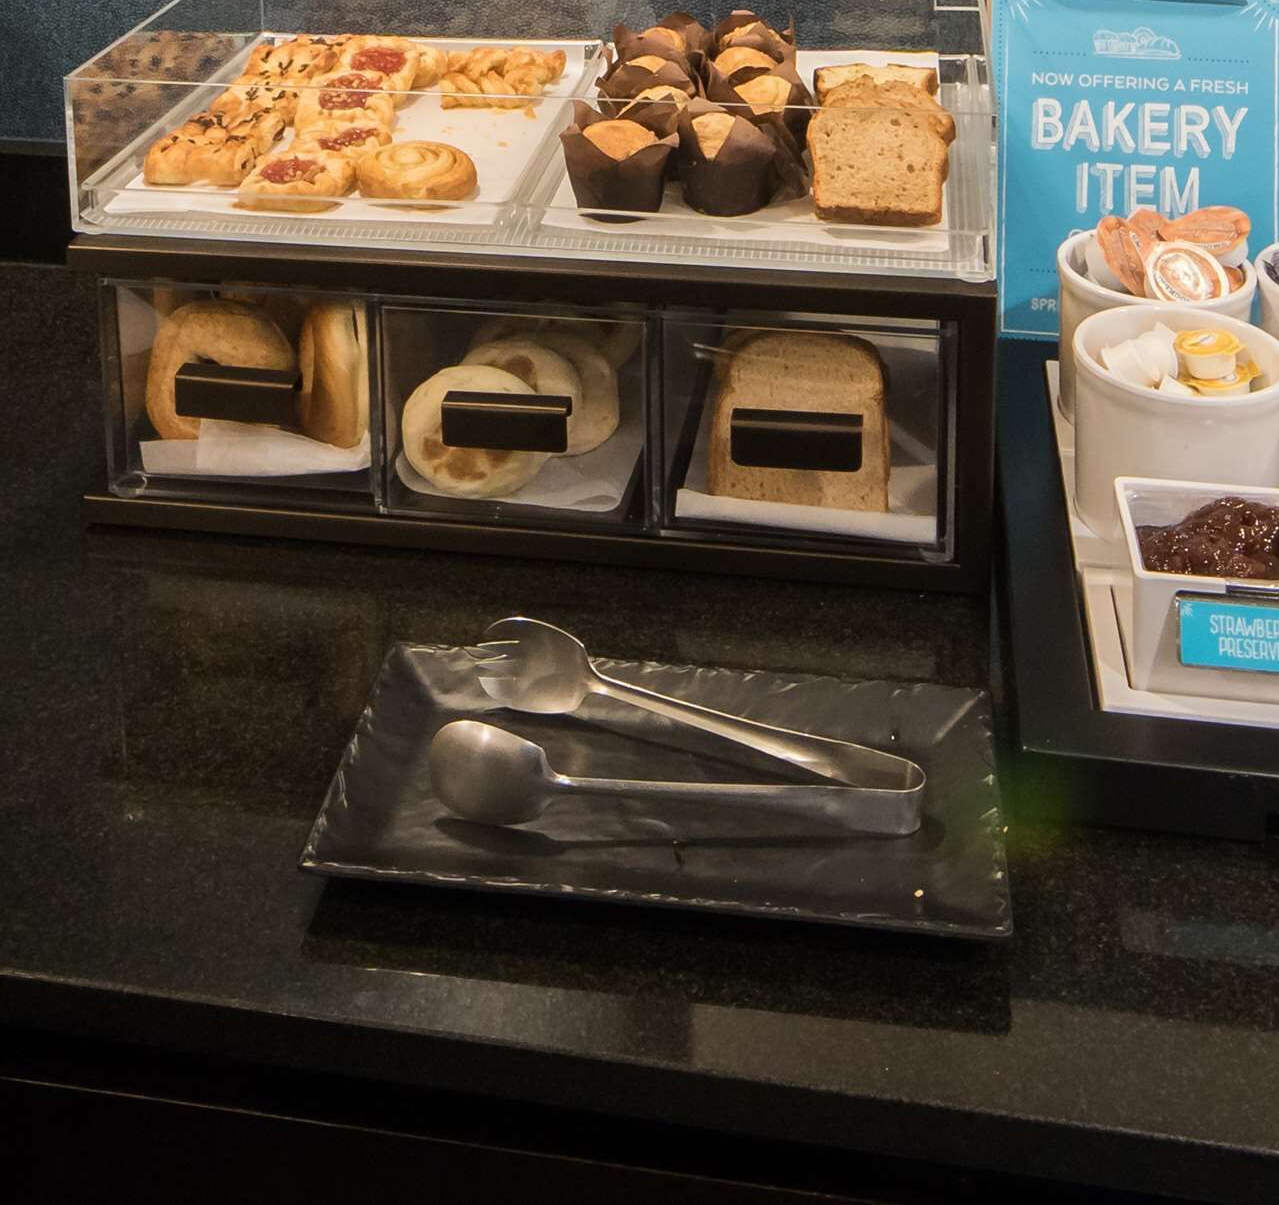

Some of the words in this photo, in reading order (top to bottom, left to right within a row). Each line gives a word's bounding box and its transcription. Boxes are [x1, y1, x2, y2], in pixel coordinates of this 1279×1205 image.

[1031, 72, 1074, 86] NOW
[1078, 73, 1170, 91] OFFERING
[1173, 79, 1186, 92] A
[1190, 79, 1249, 94] FRESH
[1031, 97, 1249, 161] BAKERY
[1076, 162, 1200, 221] ITEM
[1030, 297, 1058, 313] SPR
